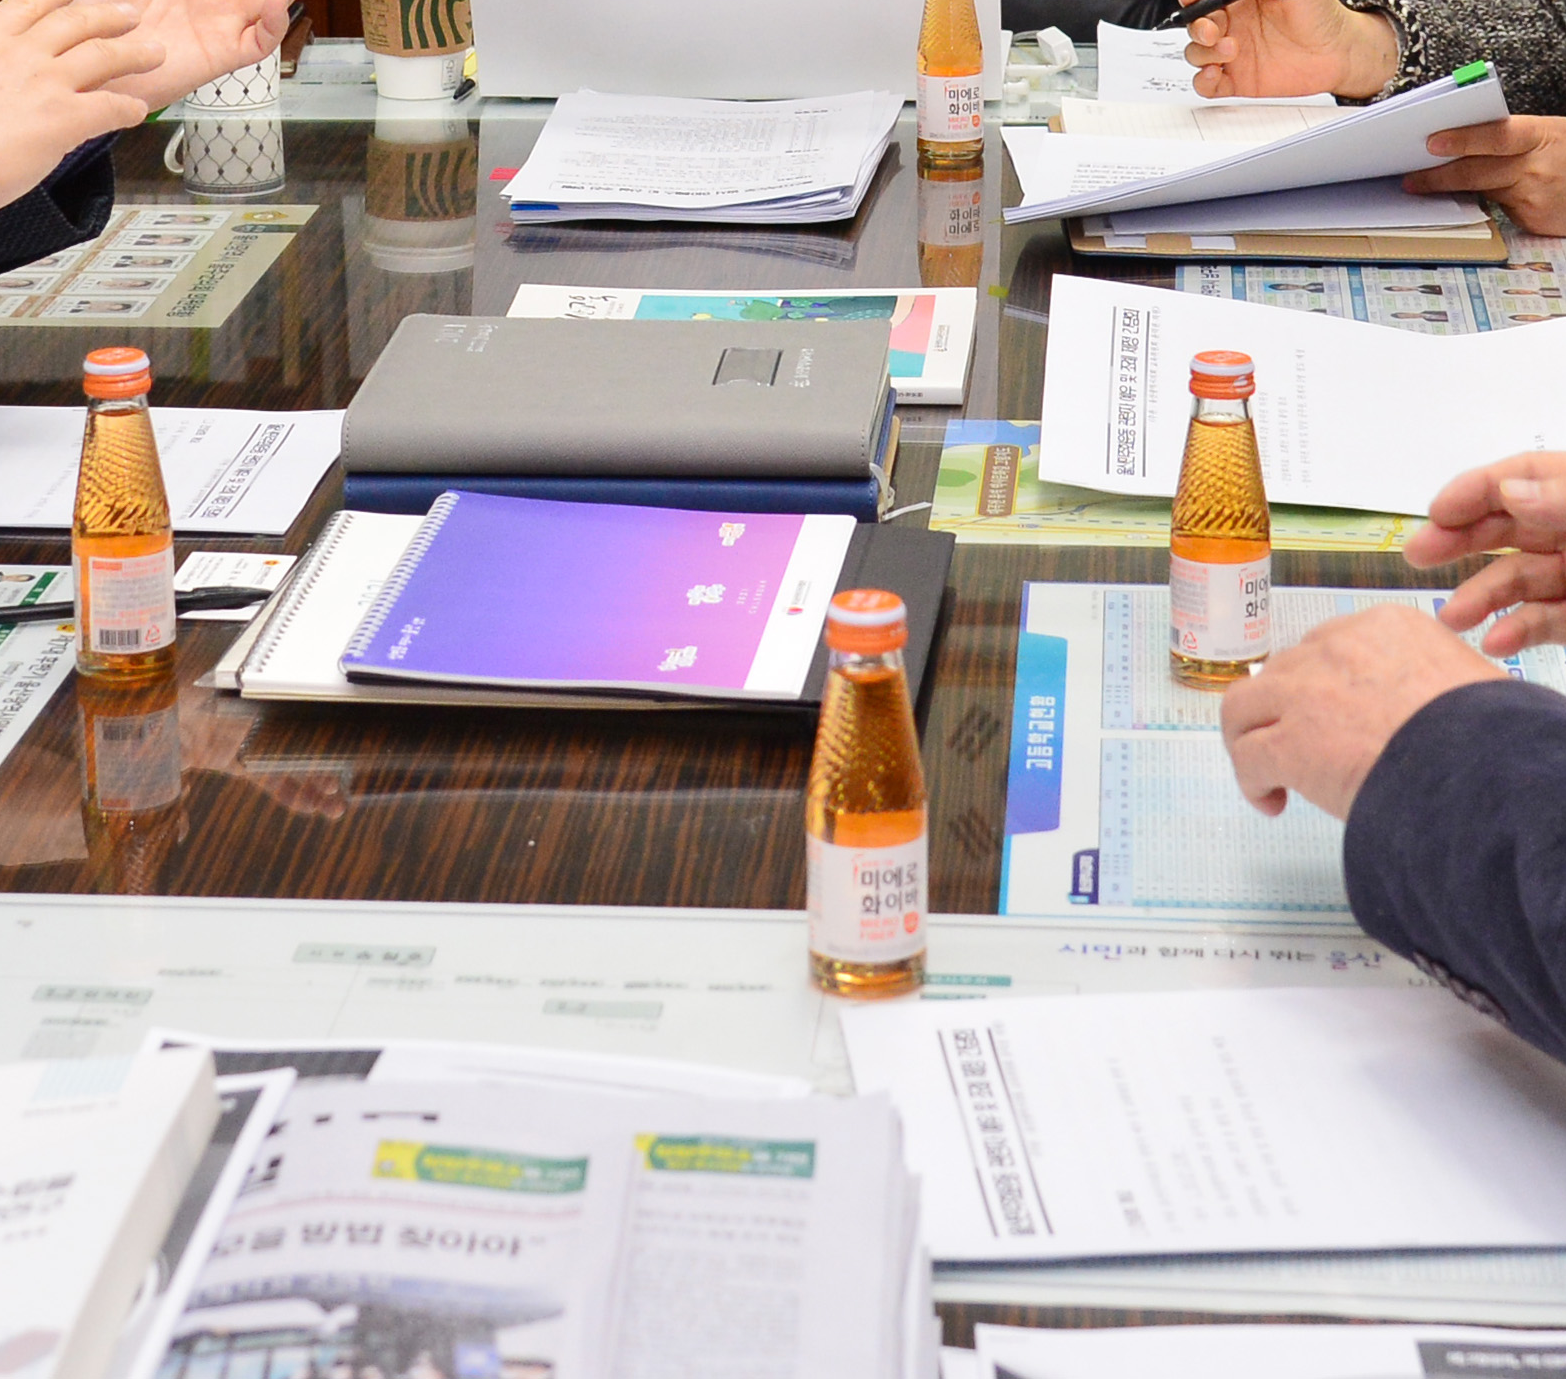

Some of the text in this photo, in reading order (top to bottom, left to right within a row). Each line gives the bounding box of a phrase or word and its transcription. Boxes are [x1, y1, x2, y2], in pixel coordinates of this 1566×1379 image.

[948, 86, 980, 102] 미에로
[1245, 575, 1268, 597] 미에
[861, 862, 918, 891] 미에로
[1214, 948, 1260, 962] 다시
